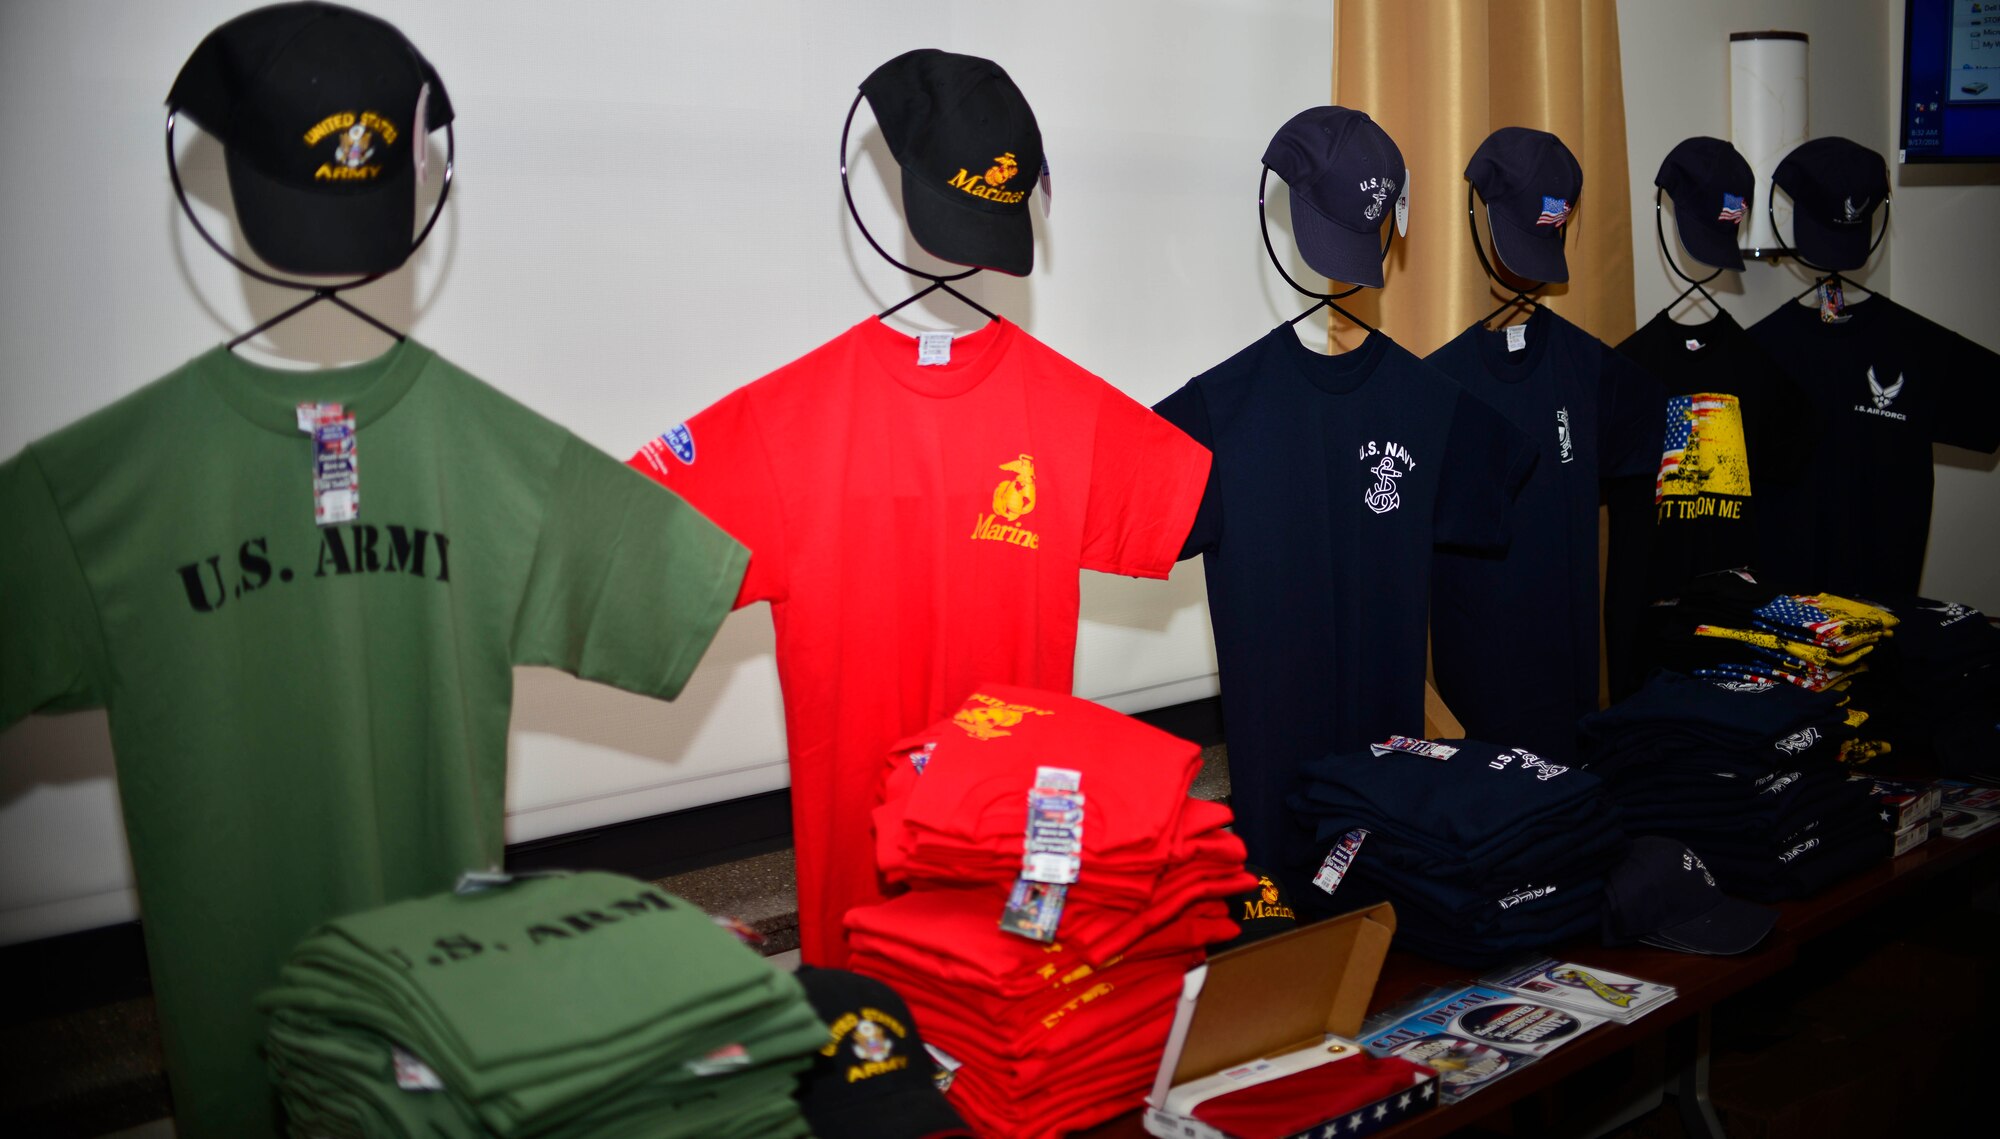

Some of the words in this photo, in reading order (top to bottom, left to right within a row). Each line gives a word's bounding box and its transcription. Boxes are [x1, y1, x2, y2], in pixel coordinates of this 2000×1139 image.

[303, 112, 356, 146] UNITED
[360, 111, 398, 145] STATES
[314, 162, 382, 181] ARMY
[1360, 177, 1379, 192] U.S.
[1866, 407, 1880, 415] AIR
[1880, 410, 1907, 421] FORCE
[1359, 440, 1381, 461] U.S.
[1384, 441, 1417, 472] NAVY
[1718, 499, 1743, 519] ME
[176, 536, 295, 613] U.S.
[313, 524, 450, 583] ARMY
[1488, 754, 1516, 770] U.S.
[1371, 1028, 1428, 1049] CAL
[1417, 993, 1499, 1026] DECAL
